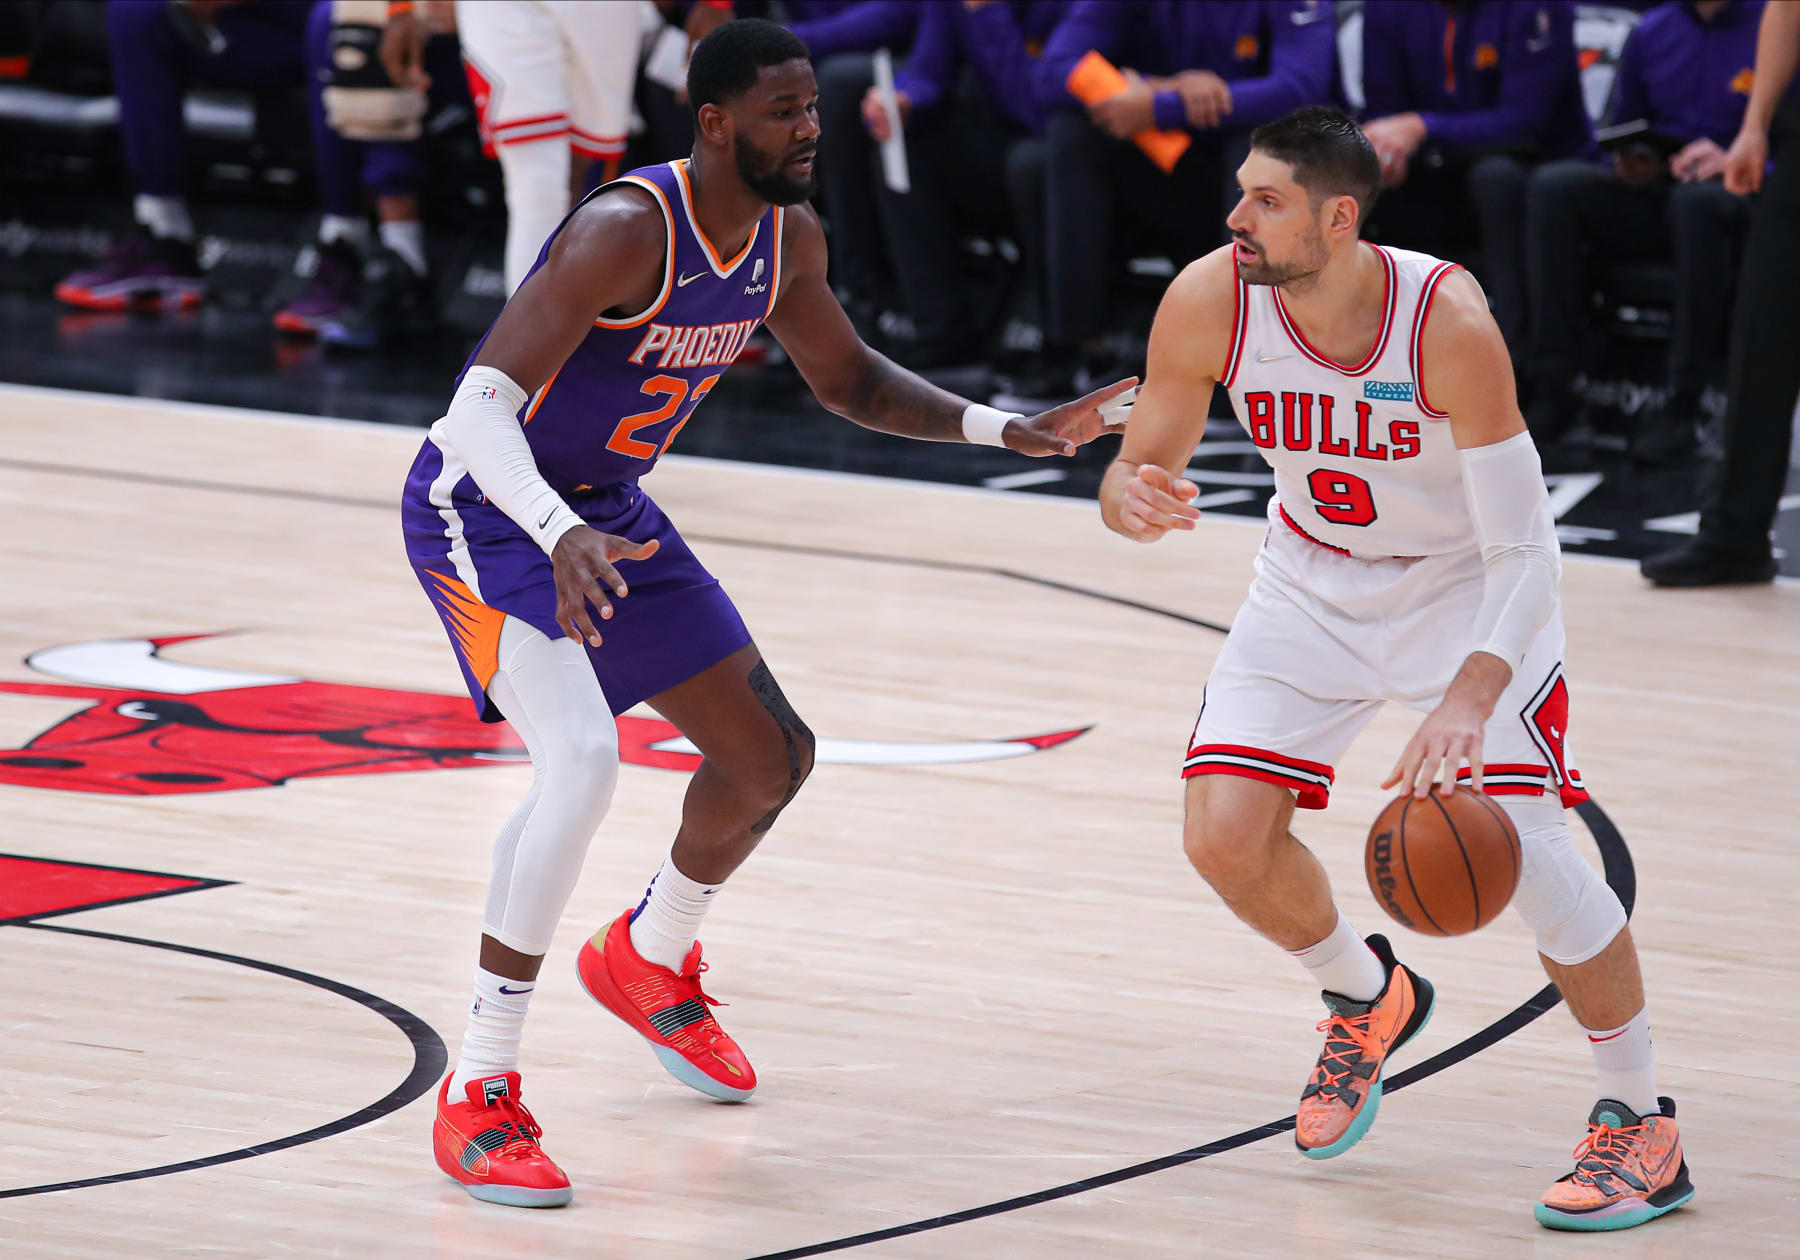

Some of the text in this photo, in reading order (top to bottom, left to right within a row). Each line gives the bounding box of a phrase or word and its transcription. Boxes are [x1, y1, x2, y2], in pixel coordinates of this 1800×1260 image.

[744, 282, 767, 296] PayPal
[1366, 381, 1413, 392] ZENNI
[1366, 391, 1412, 400] EYEWEAR
[1245, 391, 1420, 461] BULLS
[1307, 468, 1378, 527] 9
